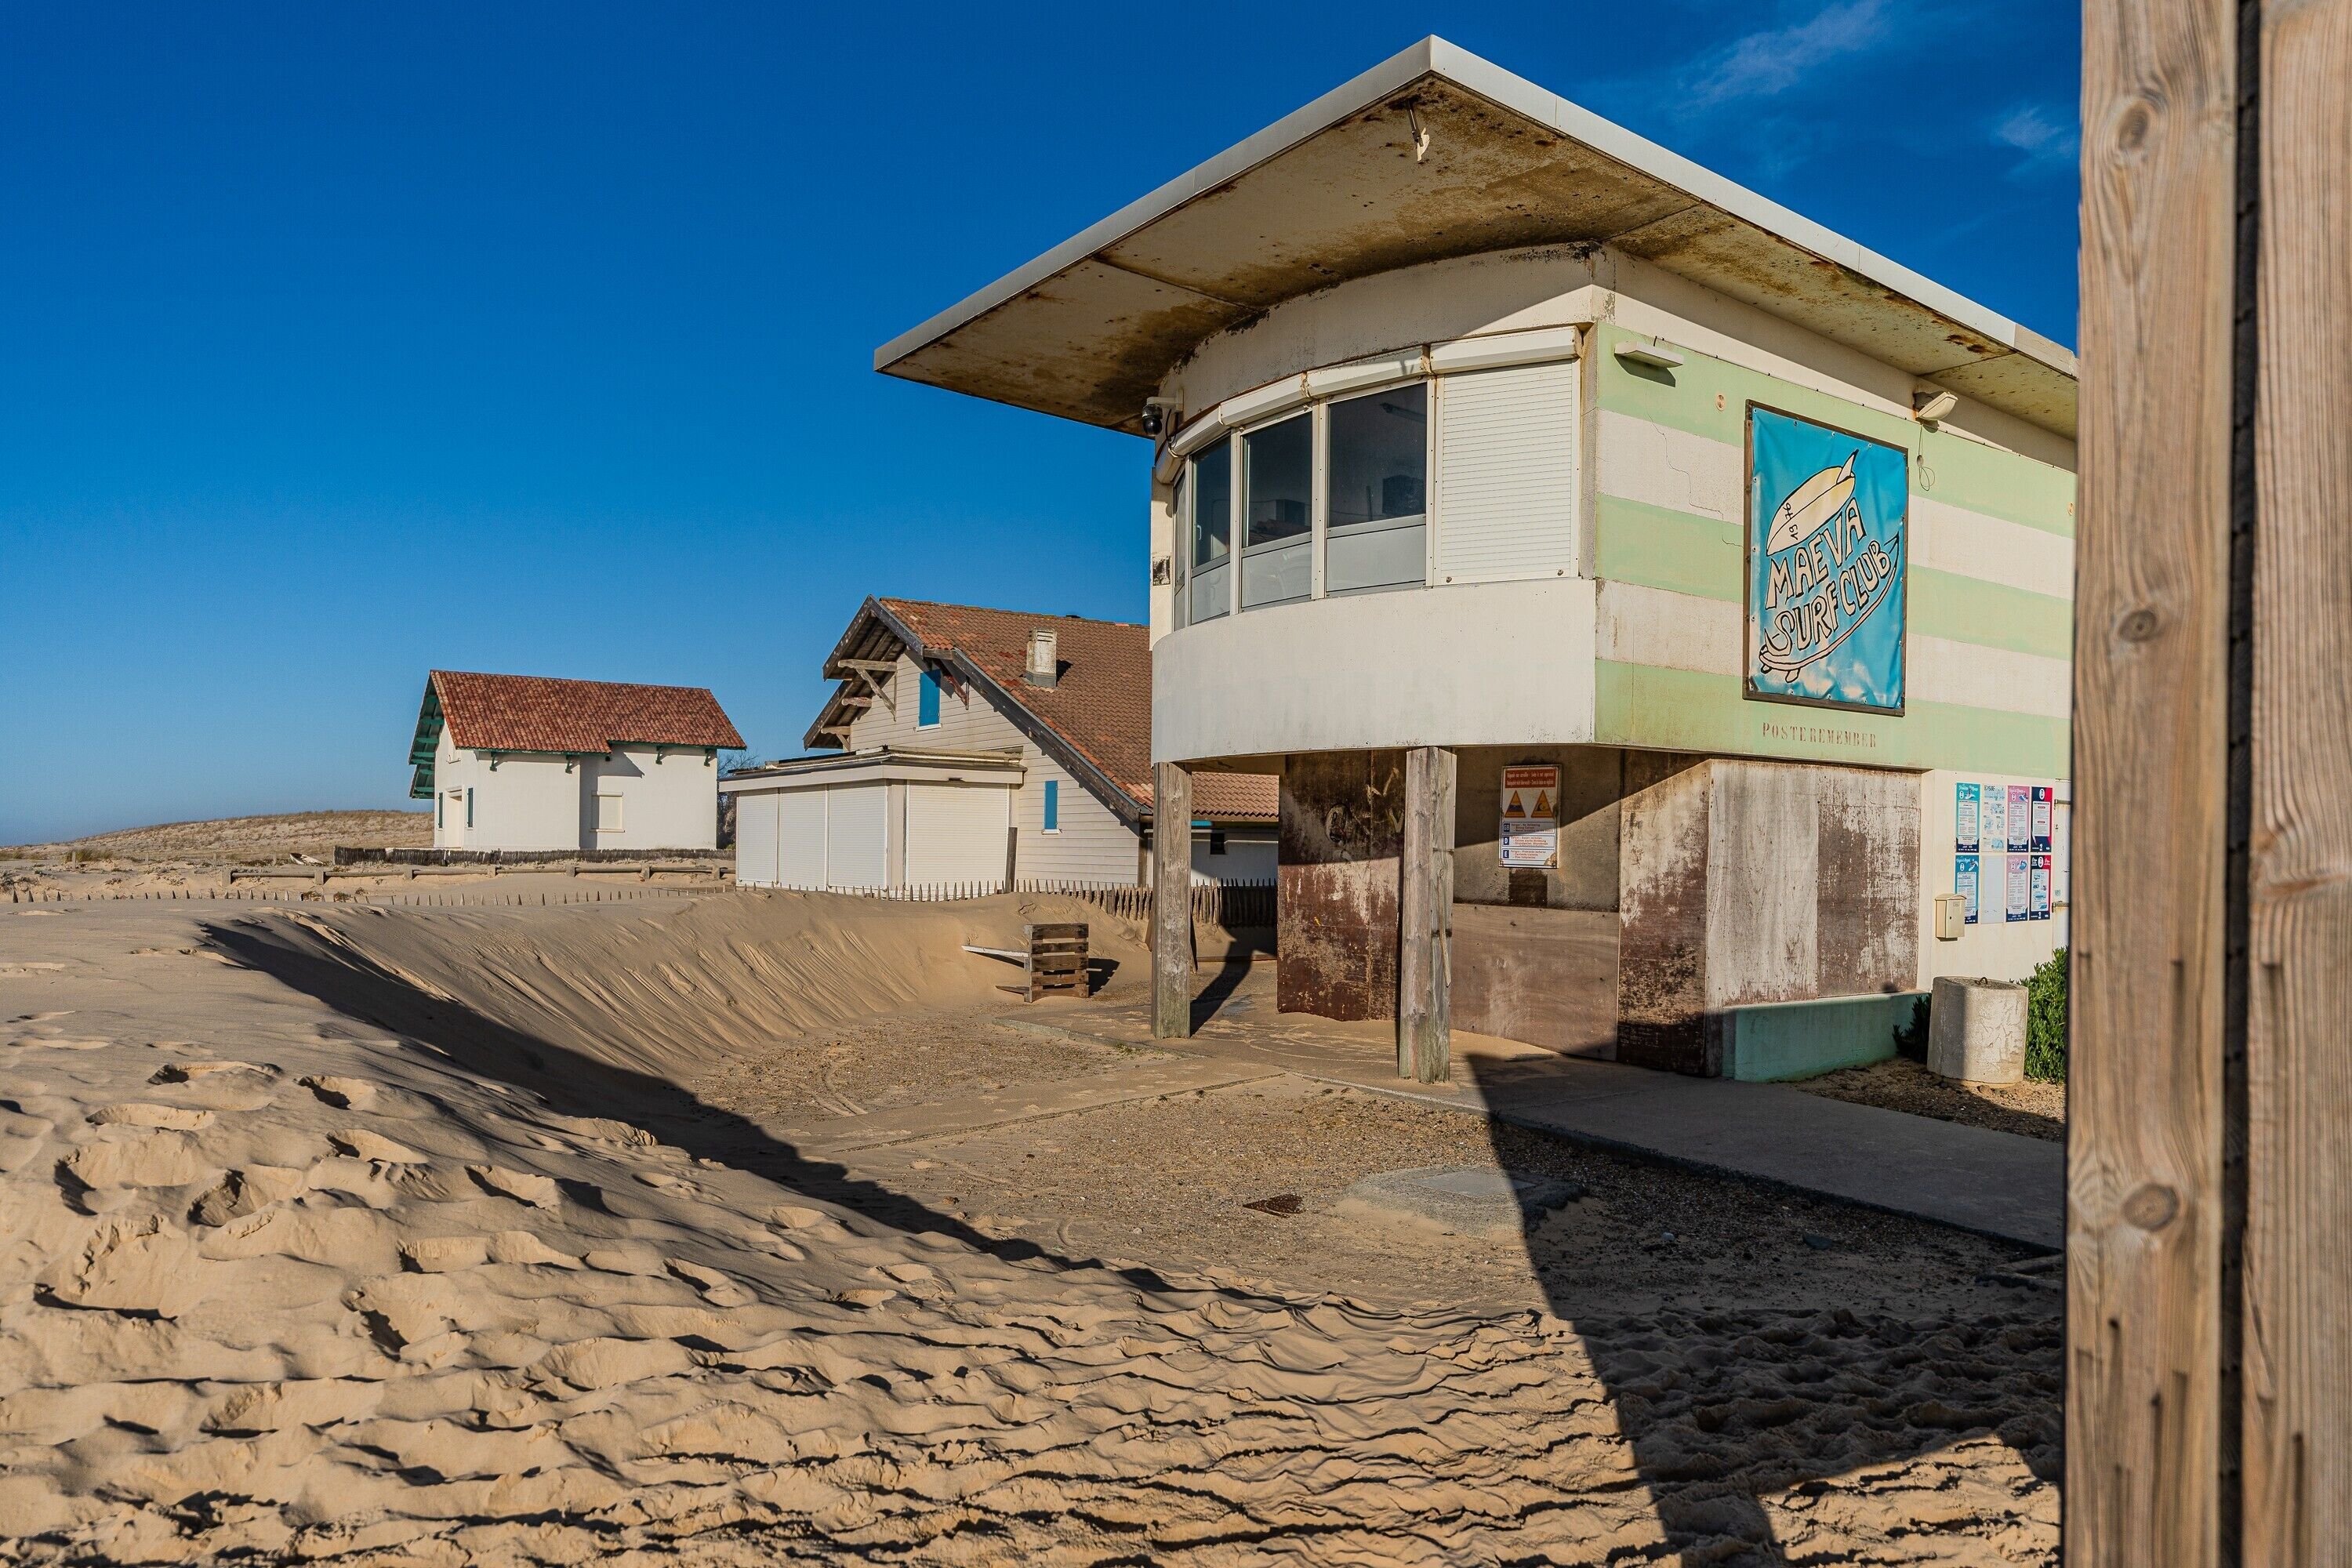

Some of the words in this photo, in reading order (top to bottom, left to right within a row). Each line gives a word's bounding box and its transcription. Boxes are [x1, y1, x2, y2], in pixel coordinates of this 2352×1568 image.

[1764, 581, 1838, 657] SURF
[1839, 540, 1891, 616] CLUB
[1765, 497, 1867, 610] MAEVA
